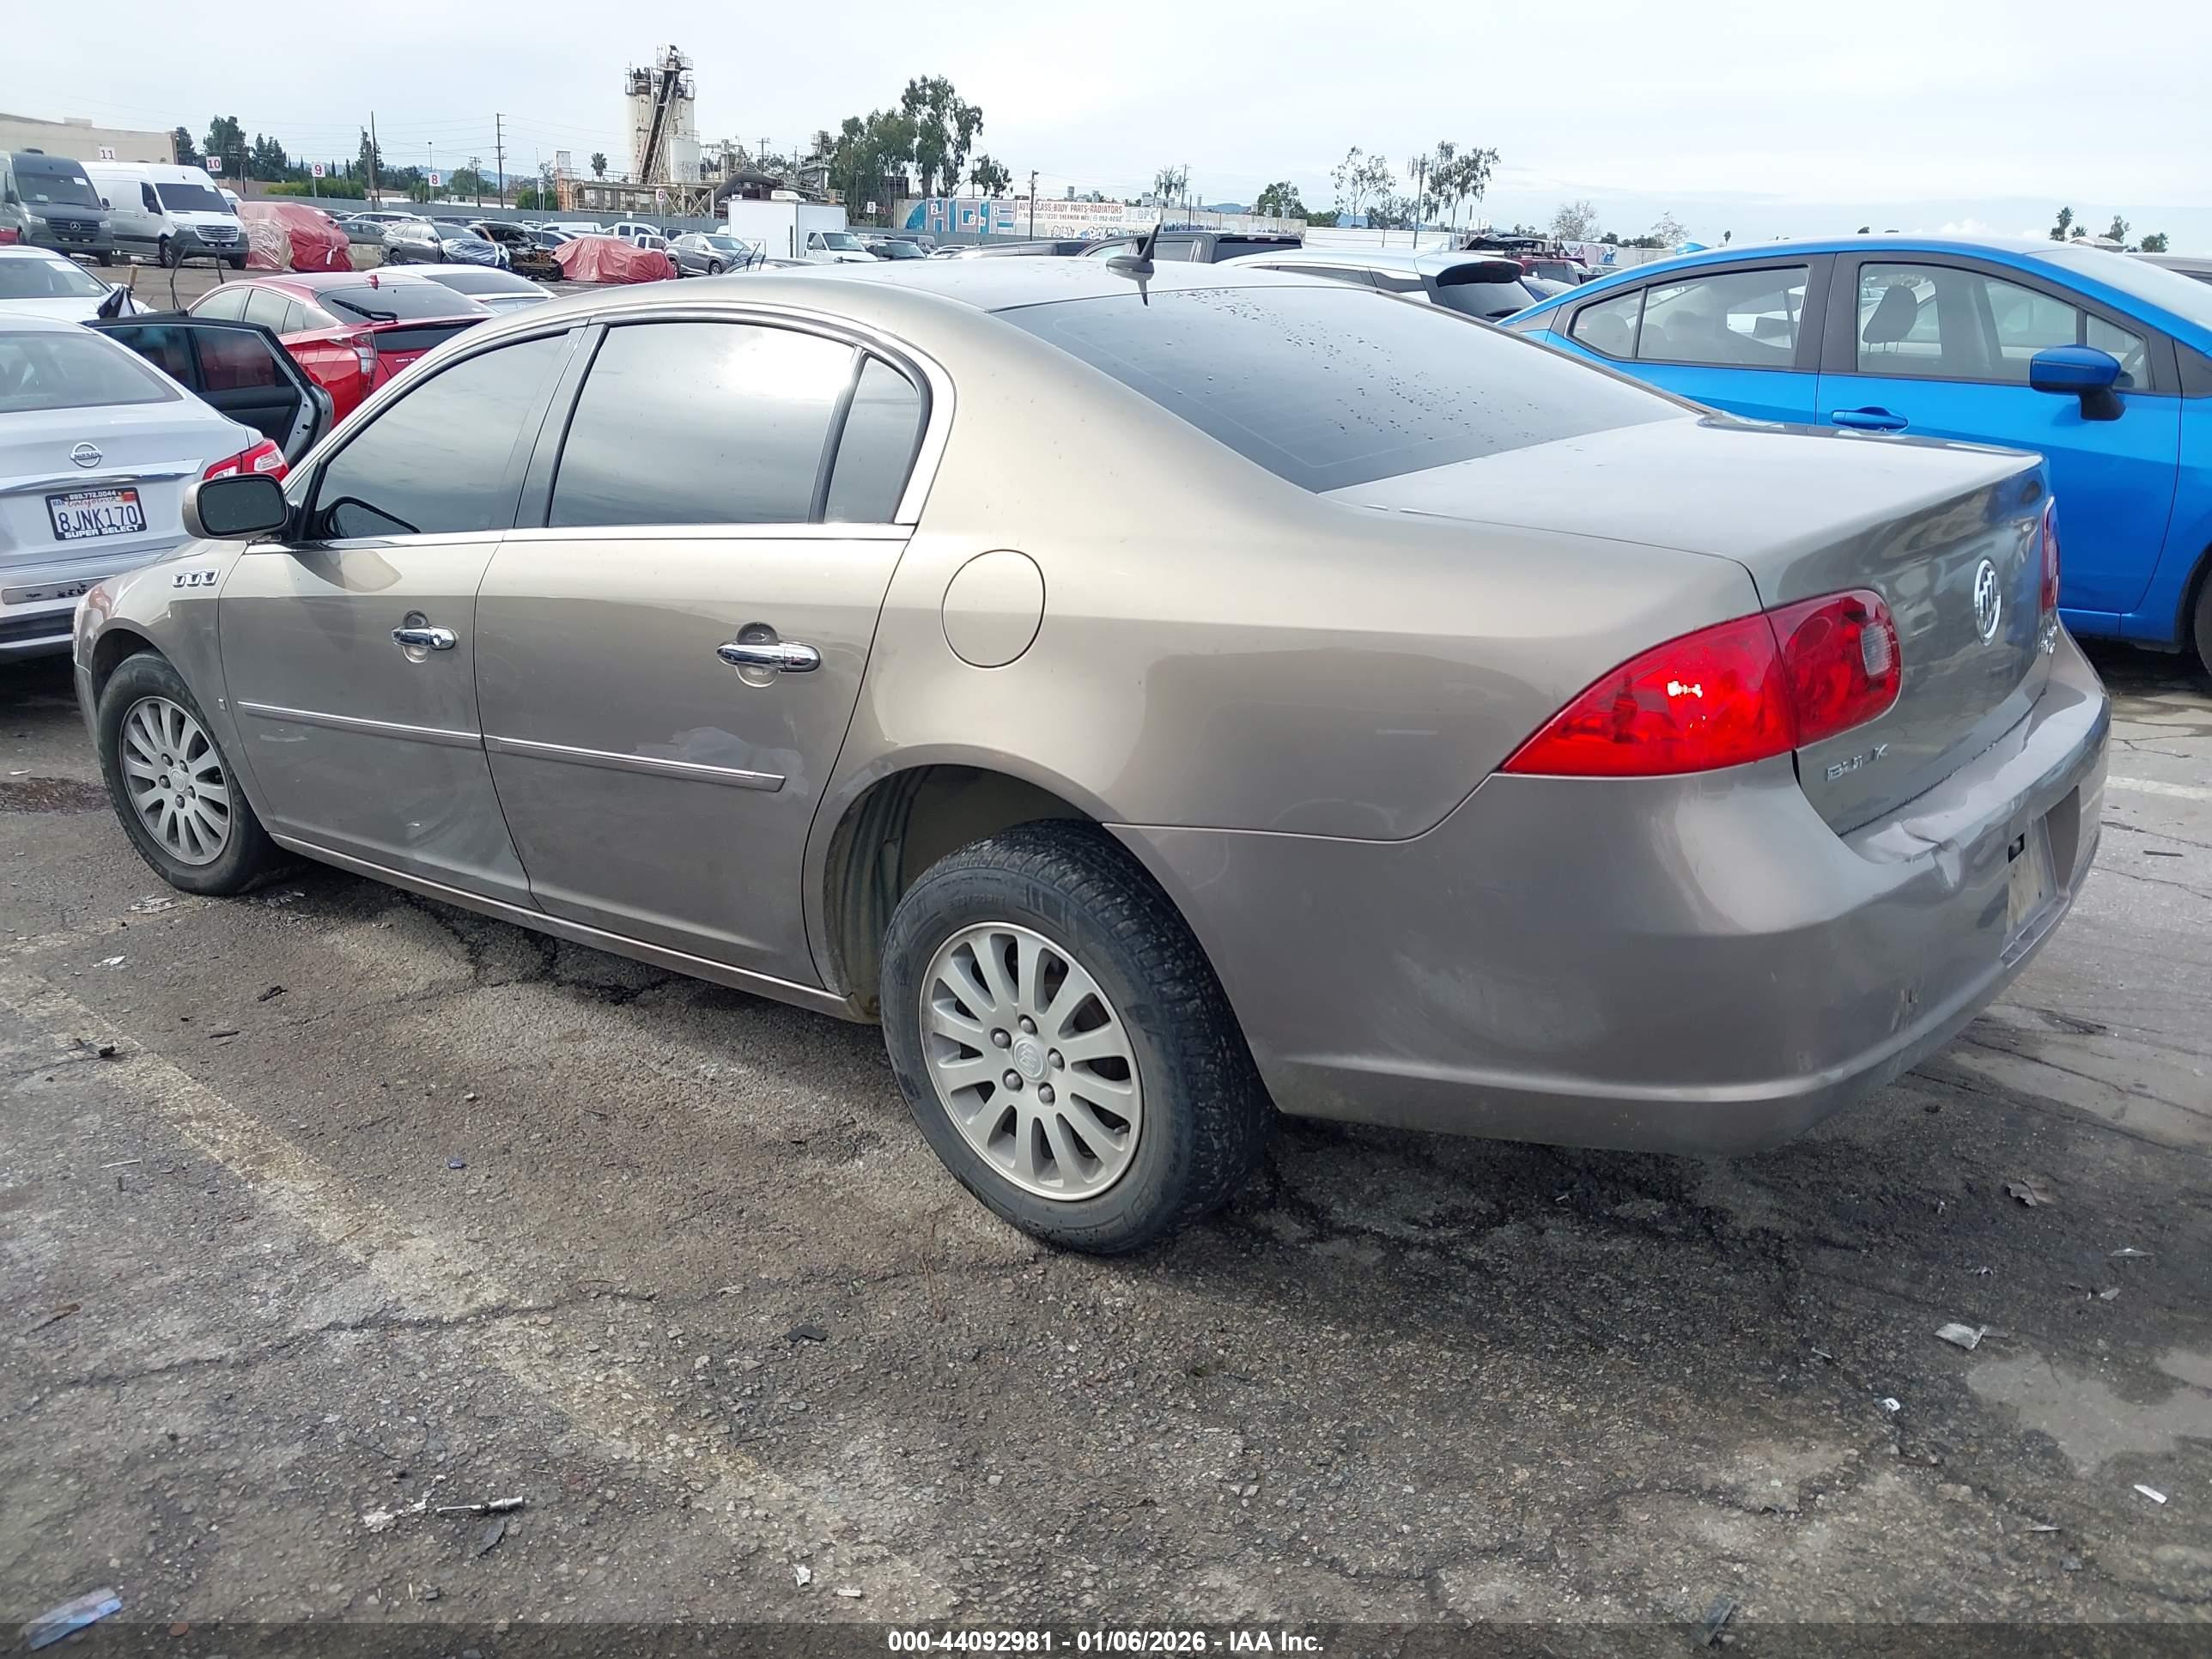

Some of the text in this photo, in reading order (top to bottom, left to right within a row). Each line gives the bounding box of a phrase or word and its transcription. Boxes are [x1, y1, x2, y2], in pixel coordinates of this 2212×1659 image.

[100, 149, 114, 160] 11
[208, 159, 221, 169] 10
[314, 164, 322, 175] 9
[431, 174, 438, 185] 8
[658, 191, 664, 200] 6
[868, 203, 874, 212] 3
[1018, 202, 1032, 211] AUTO
[58, 505, 138, 532] 8JNK170
[64, 525, 139, 538] SUPER SELECT
[1826, 744, 1888, 783] BUIK
